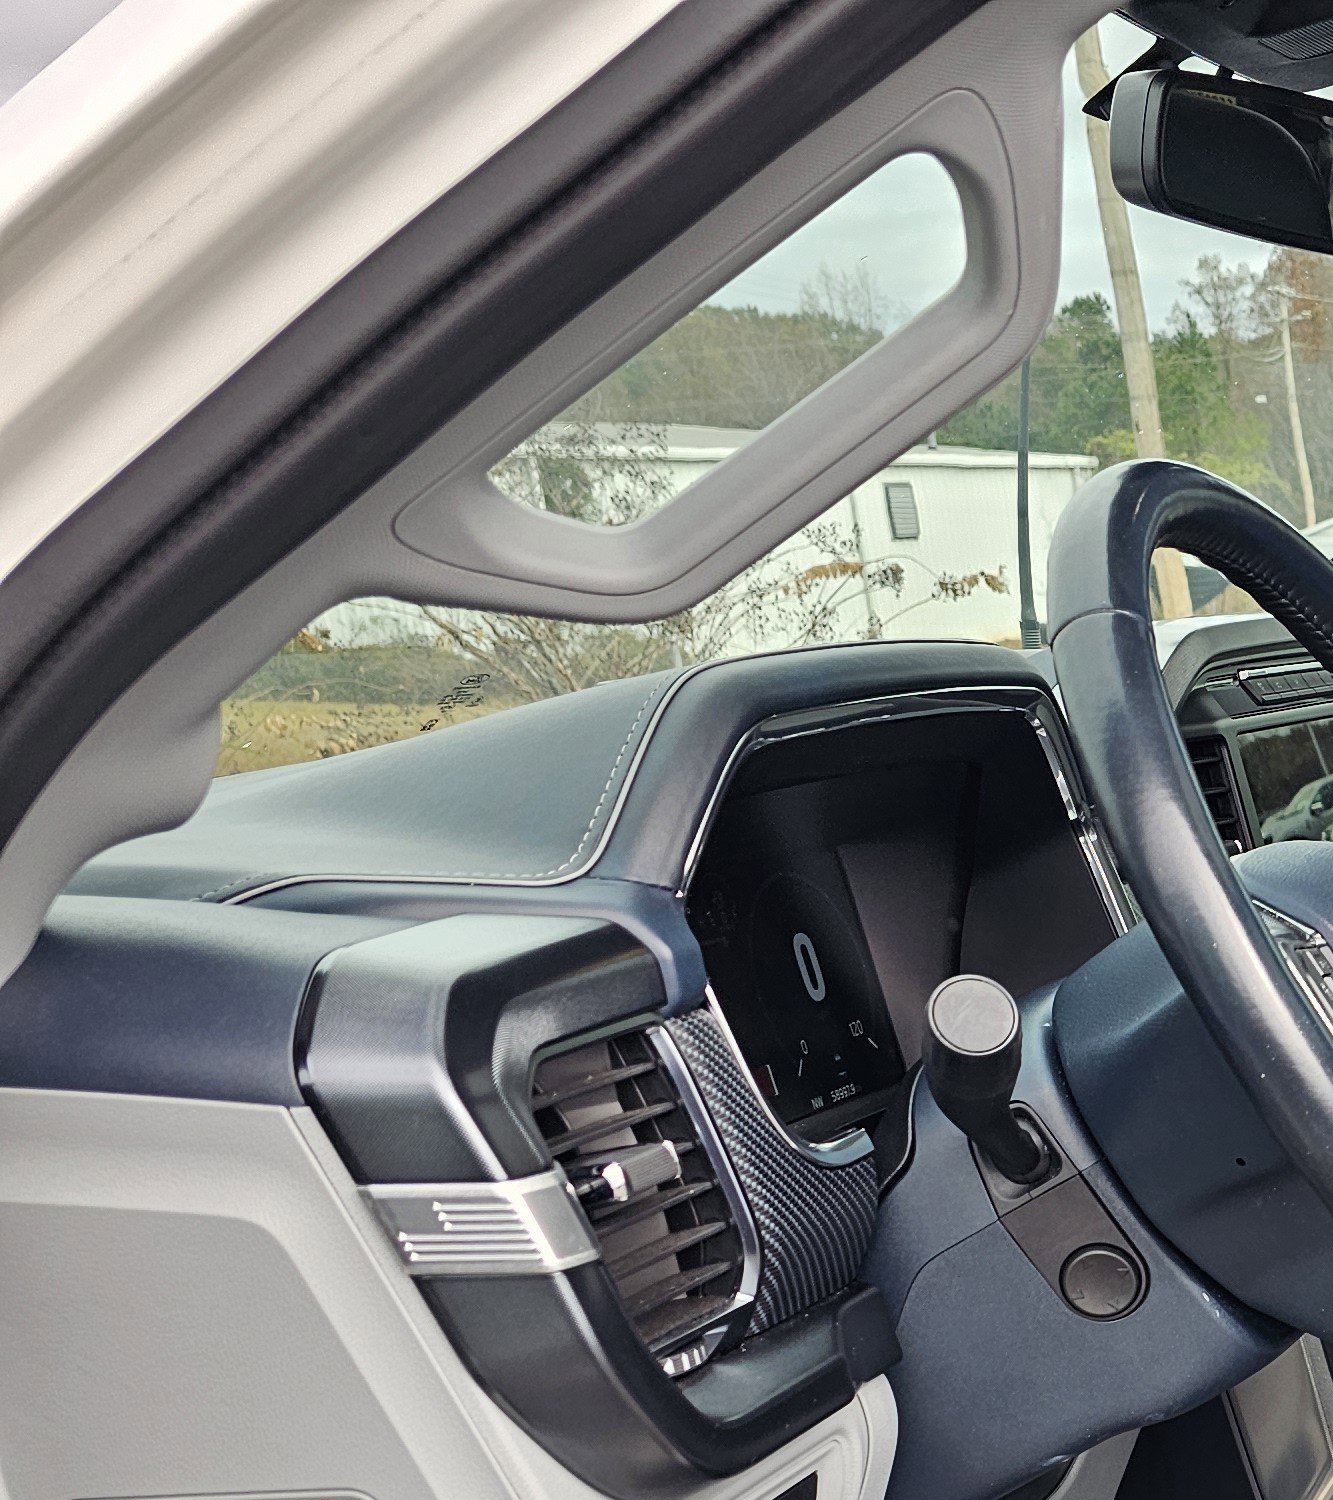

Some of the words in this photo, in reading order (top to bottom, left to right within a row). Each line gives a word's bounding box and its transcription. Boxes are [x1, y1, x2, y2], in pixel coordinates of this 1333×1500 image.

[793, 932, 826, 1002] 0
[848, 1019, 864, 1037] 120
[800, 1039, 808, 1055] 0
